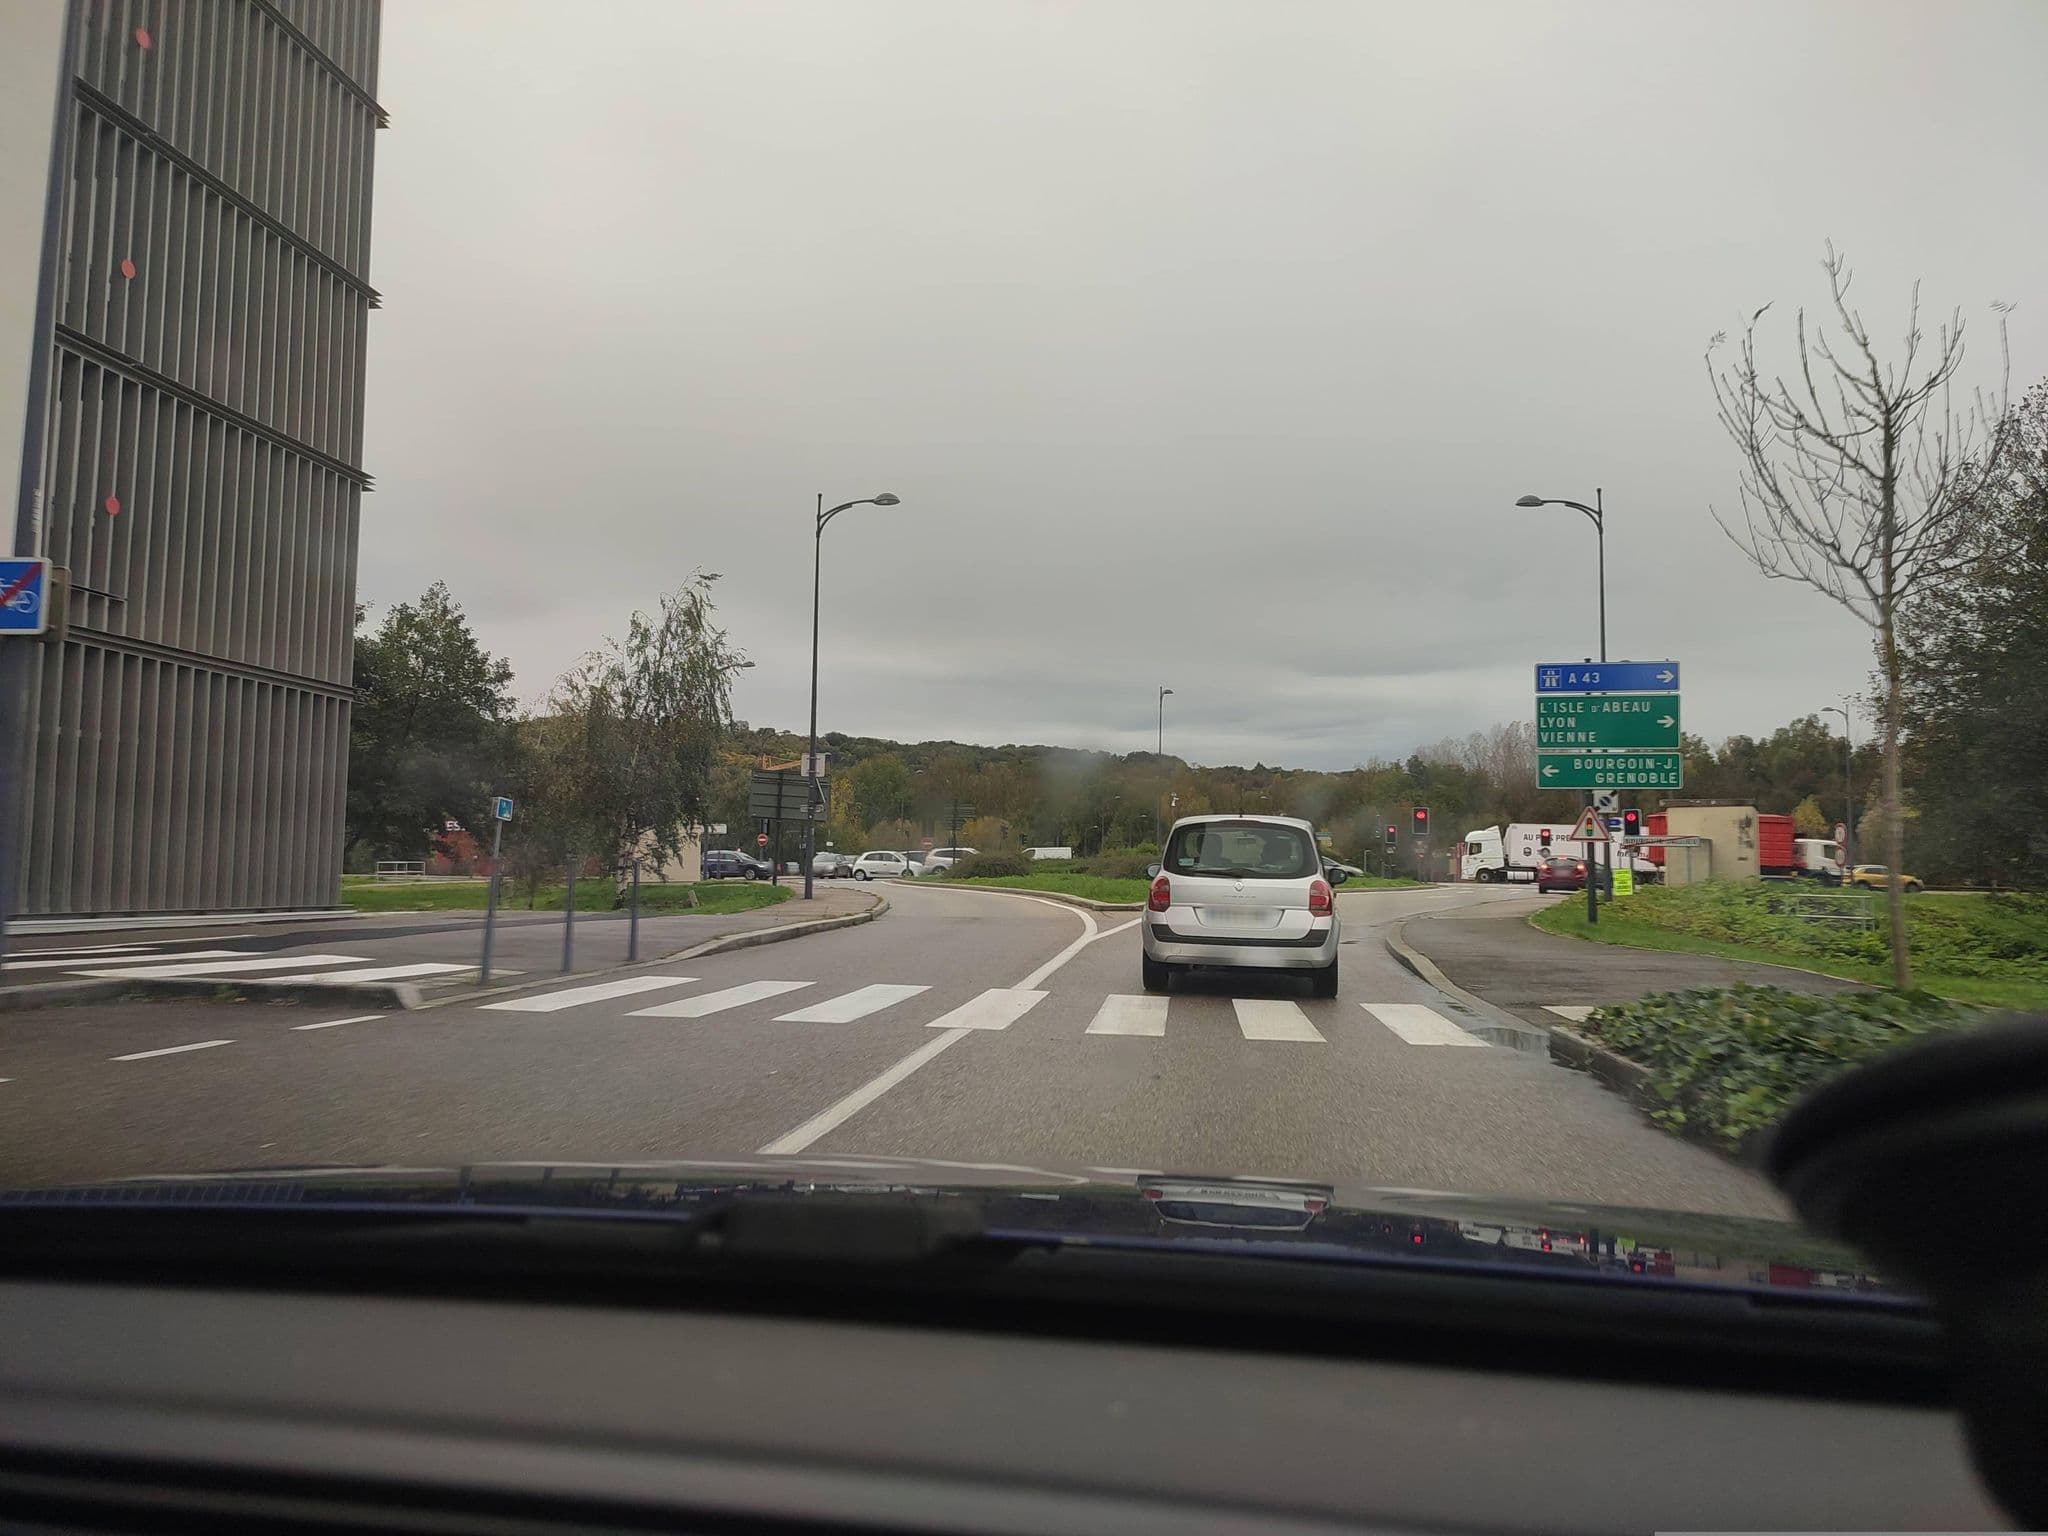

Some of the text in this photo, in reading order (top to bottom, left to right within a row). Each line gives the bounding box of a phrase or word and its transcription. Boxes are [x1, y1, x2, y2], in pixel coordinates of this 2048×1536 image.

[1568, 672, 1600, 684] A 43
[1540, 702, 1584, 713] L'ISLE
[1540, 717, 1576, 728] LYON
[1540, 731, 1597, 743] VIENNE
[1573, 758, 1677, 770] BOURGOIN-J.
[1595, 772, 1678, 784] GRENOBLE
[1523, 833, 1533, 841] AU
